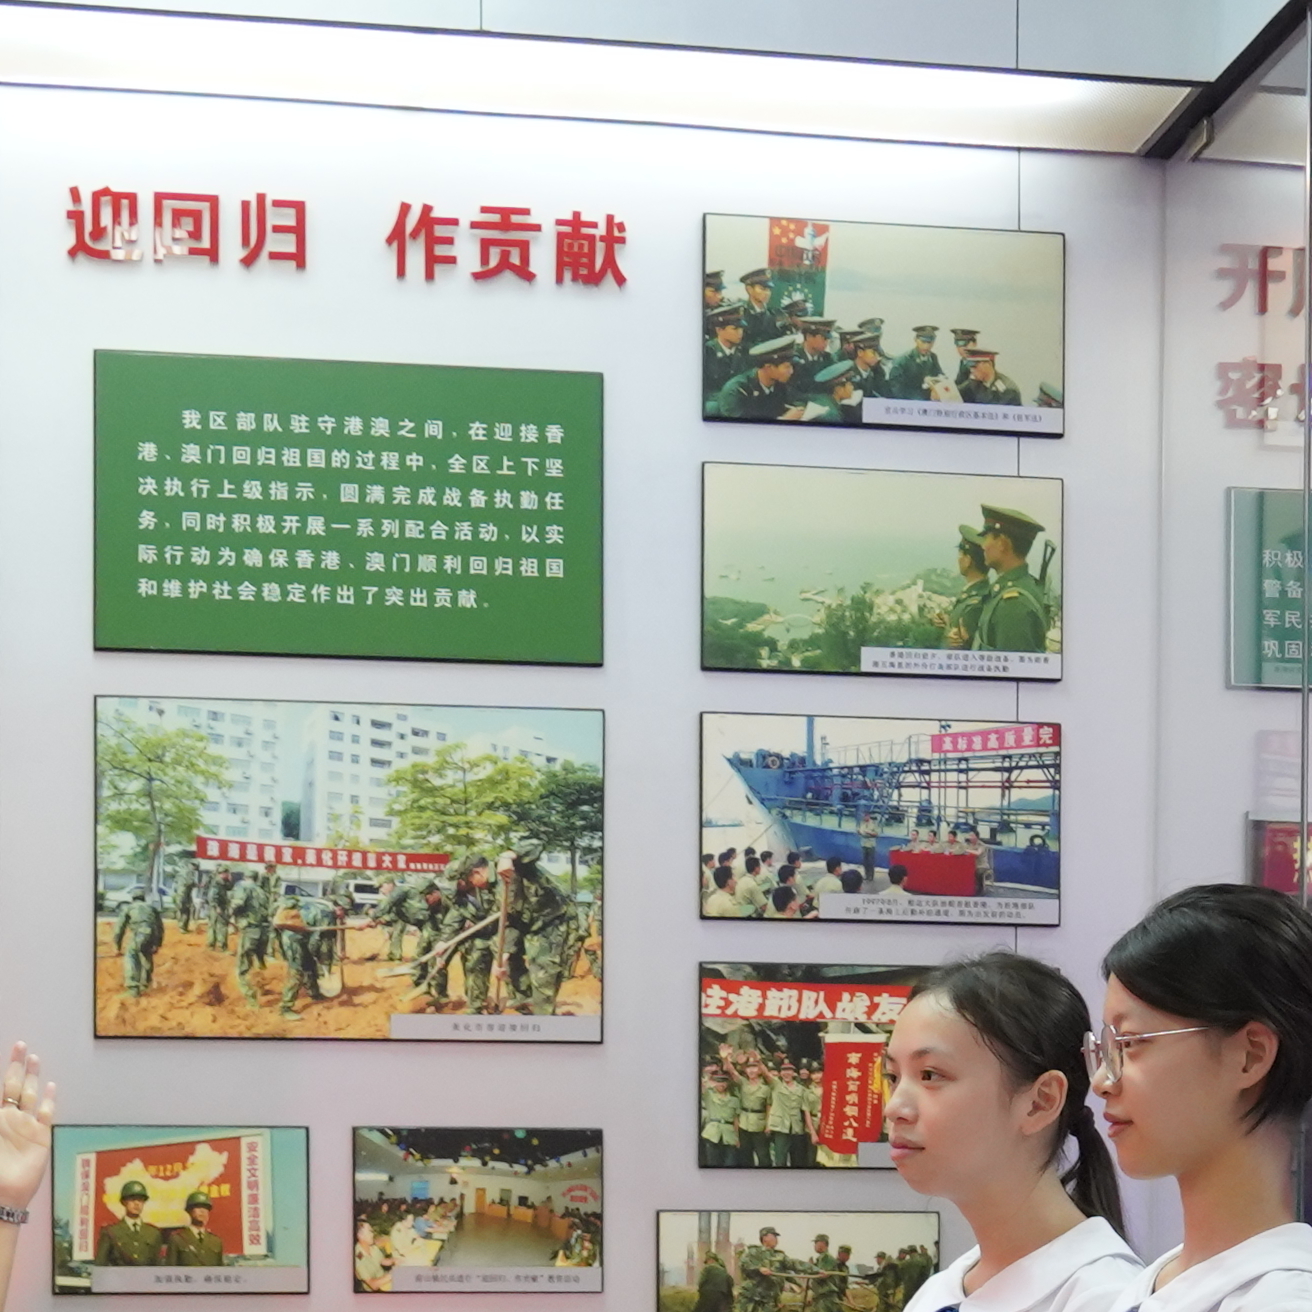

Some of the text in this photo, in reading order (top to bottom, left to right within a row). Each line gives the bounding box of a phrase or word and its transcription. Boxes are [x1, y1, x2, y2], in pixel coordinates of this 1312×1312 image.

[66, 186, 627, 286] 迎回归 作贡献
[182, 409, 564, 444] 我区部队驻守港澳之间,在迎接香
[137, 442, 564, 477] 港、澳门回归祖国的过程中,全区上下坚
[137, 476, 564, 510] 决执行上级指示,圆满完成战备执勤任
[137, 544, 564, 578] 际行动为确保香港、澳门顺利回归祖国
[137, 578, 490, 609] 和维护社会稳定作出了突出贡献。
